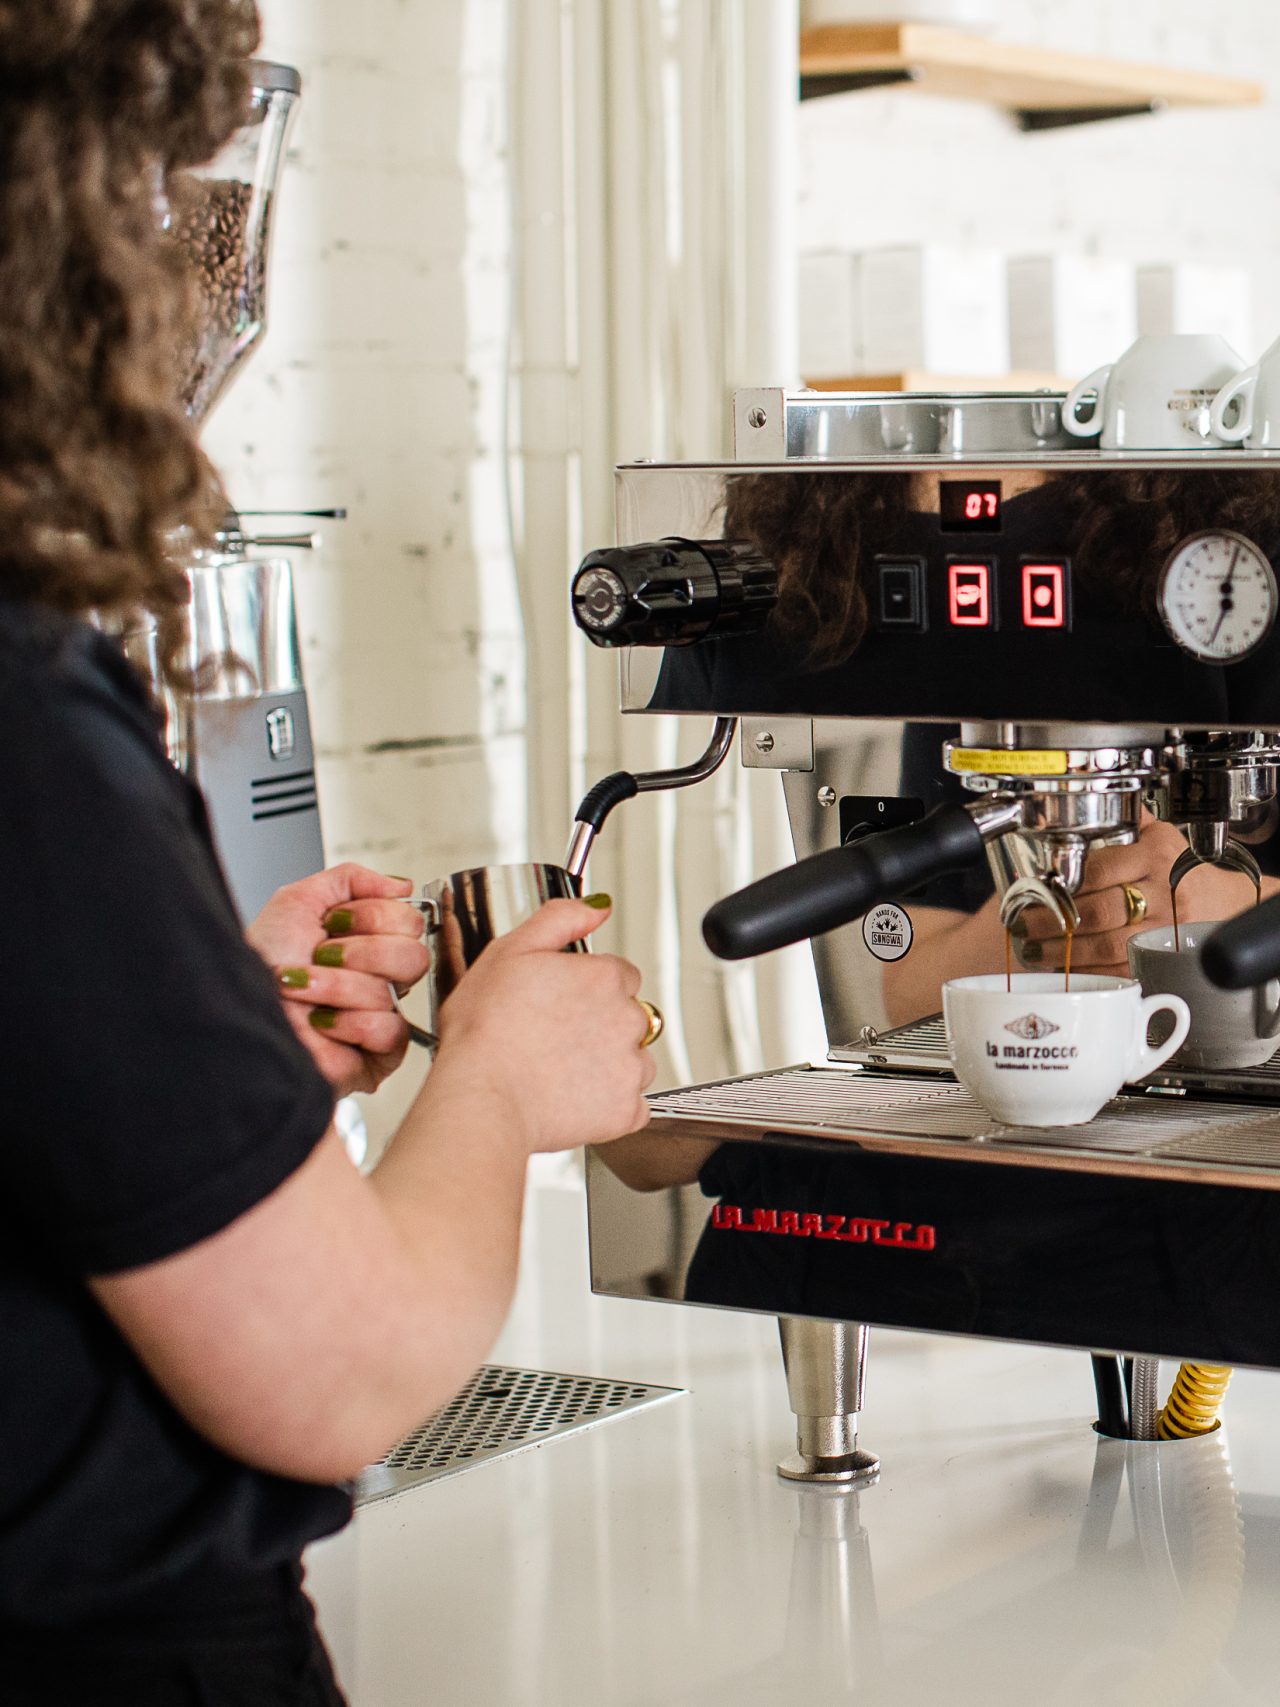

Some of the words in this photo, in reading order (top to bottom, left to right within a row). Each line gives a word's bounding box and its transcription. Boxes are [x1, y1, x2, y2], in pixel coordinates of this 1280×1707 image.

[965, 493, 997, 519] 07
[873, 933, 901, 945] SONGWA
[986, 1040, 998, 1057] la
